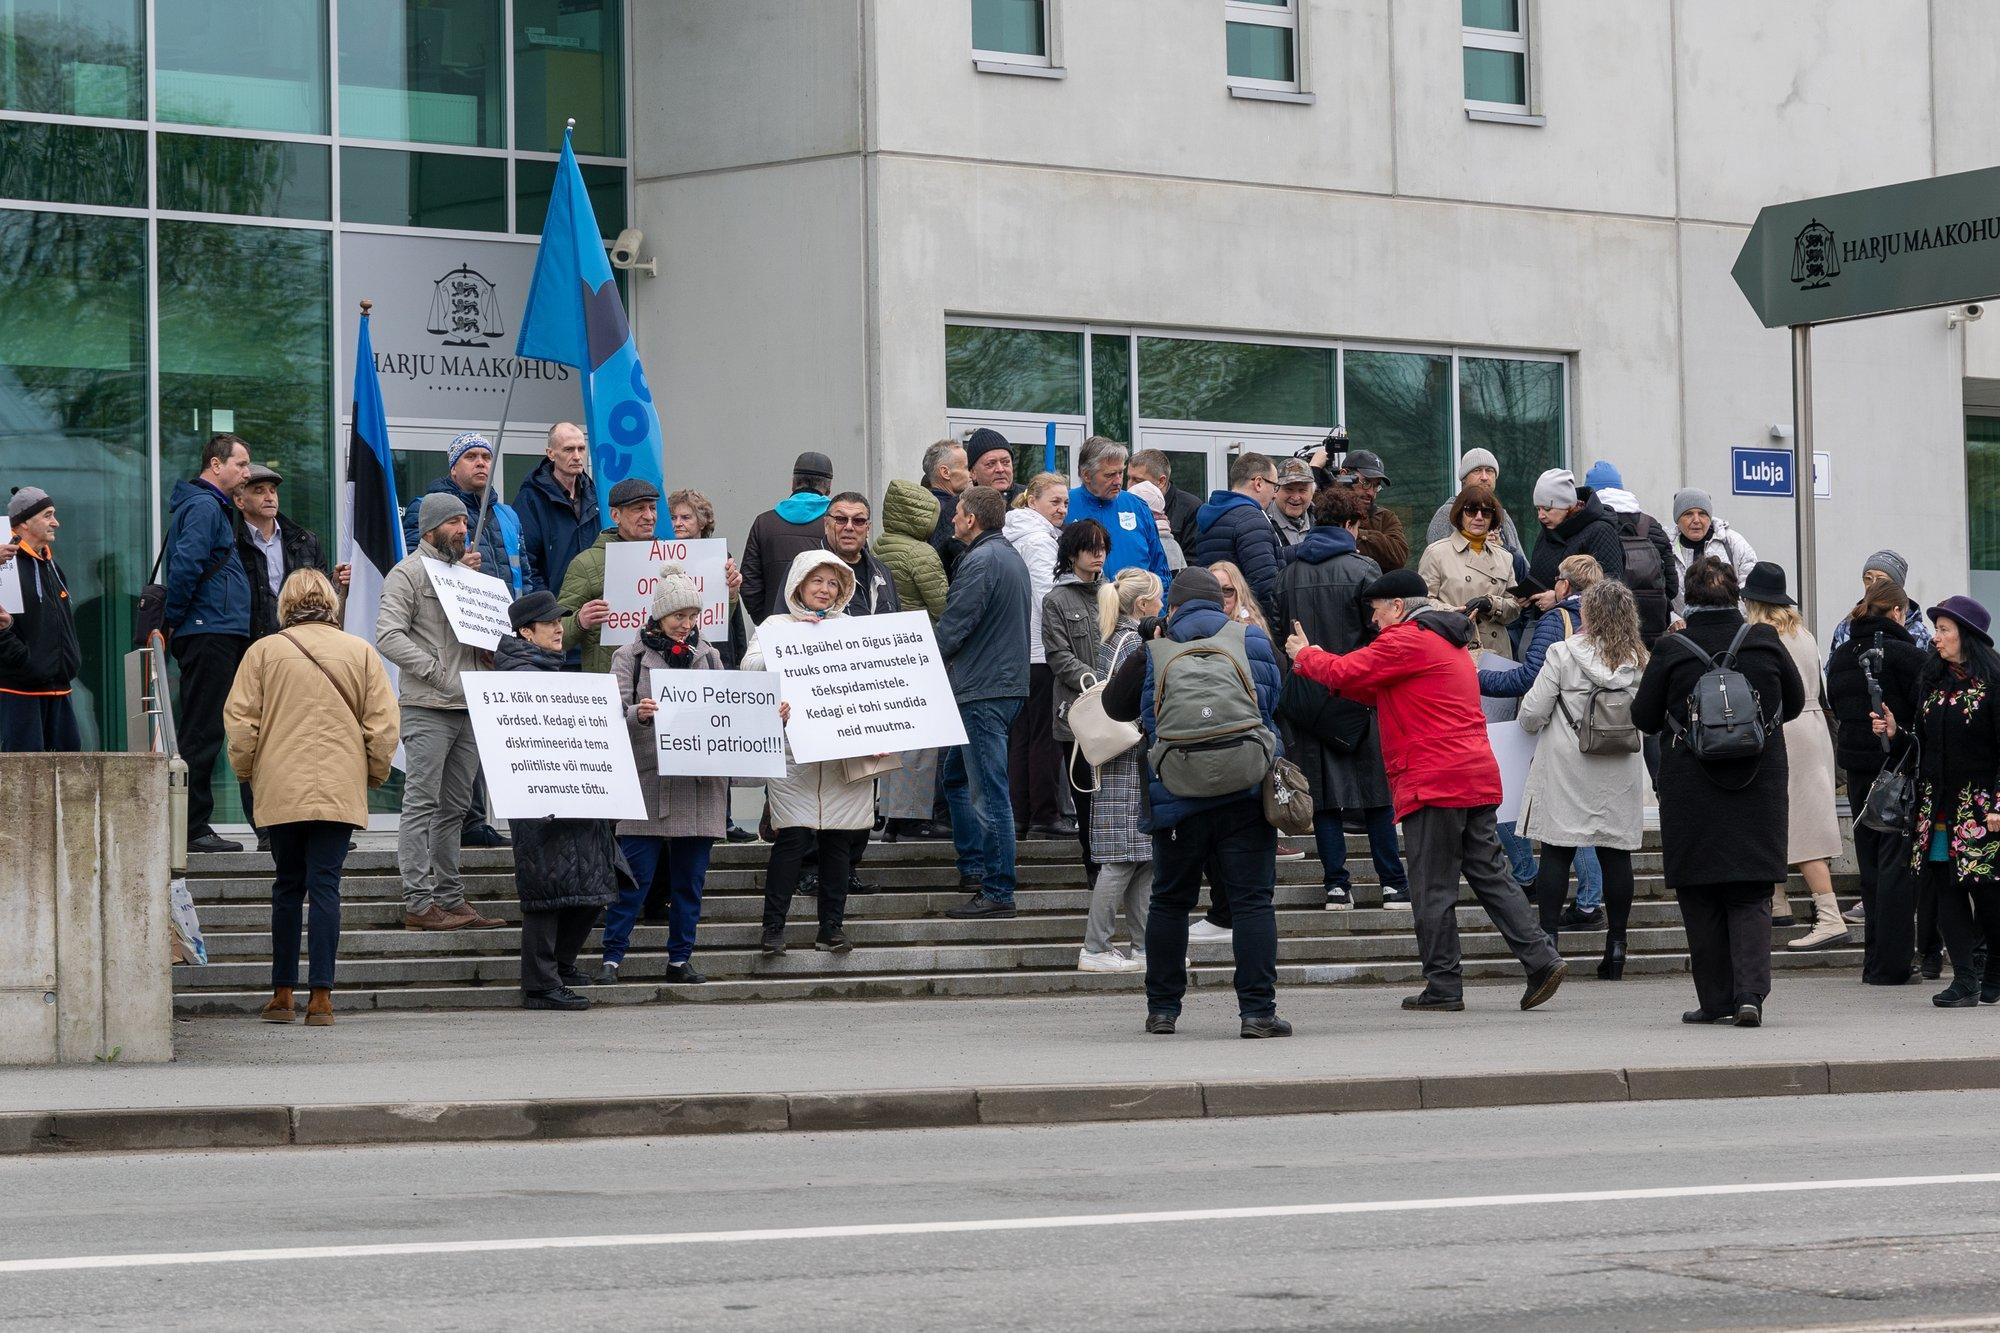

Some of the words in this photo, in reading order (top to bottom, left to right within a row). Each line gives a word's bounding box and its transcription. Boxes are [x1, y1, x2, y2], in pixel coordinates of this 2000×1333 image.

[1843, 233, 1901, 263] HARJU
[440, 355, 569, 381] MAAKOHUS
[1743, 460, 1784, 486] Lubja
[649, 540, 687, 562] Aivo
[775, 645, 783, 659] §
[846, 638, 860, 649] on
[862, 635, 891, 651] õigus
[893, 631, 923, 648] jääda
[784, 664, 821, 678] truuks
[823, 662, 847, 675] oma
[850, 653, 917, 672] arvamustele
[918, 652, 930, 667] ja
[659, 686, 697, 703] Aivo
[703, 687, 775, 706] Peterson
[811, 677, 909, 697] tõekspidamistele.
[482, 691, 490, 705] §
[493, 692, 509, 704] 12.
[510, 691, 533, 704] Kõik
[535, 694, 549, 704] on
[551, 691, 590, 705] seaduse
[592, 695, 608, 705] ees
[806, 704, 845, 720] Kedagi
[846, 703, 857, 715] ei
[859, 699, 882, 713] tohi
[884, 695, 927, 711] sundida
[496, 714, 542, 726] võrdsed.
[544, 714, 577, 729] Kedagi
[578, 715, 588, 727] ei
[589, 715, 608, 728] tohi
[710, 714, 731, 728] on
[837, 723, 862, 739] neid
[864, 719, 916, 735] muutma.
[505, 737, 583, 750] diskrimineerida
[585, 739, 609, 750] tema
[660, 733, 701, 752] Eesti
[707, 736, 782, 756] patrioot!!!
[511, 759, 561, 774] poliitiliste
[563, 760, 578, 772] või
[580, 760, 613, 773] muude
[527, 783, 580, 795] arvamuste
[582, 782, 609, 796] tõttu.
